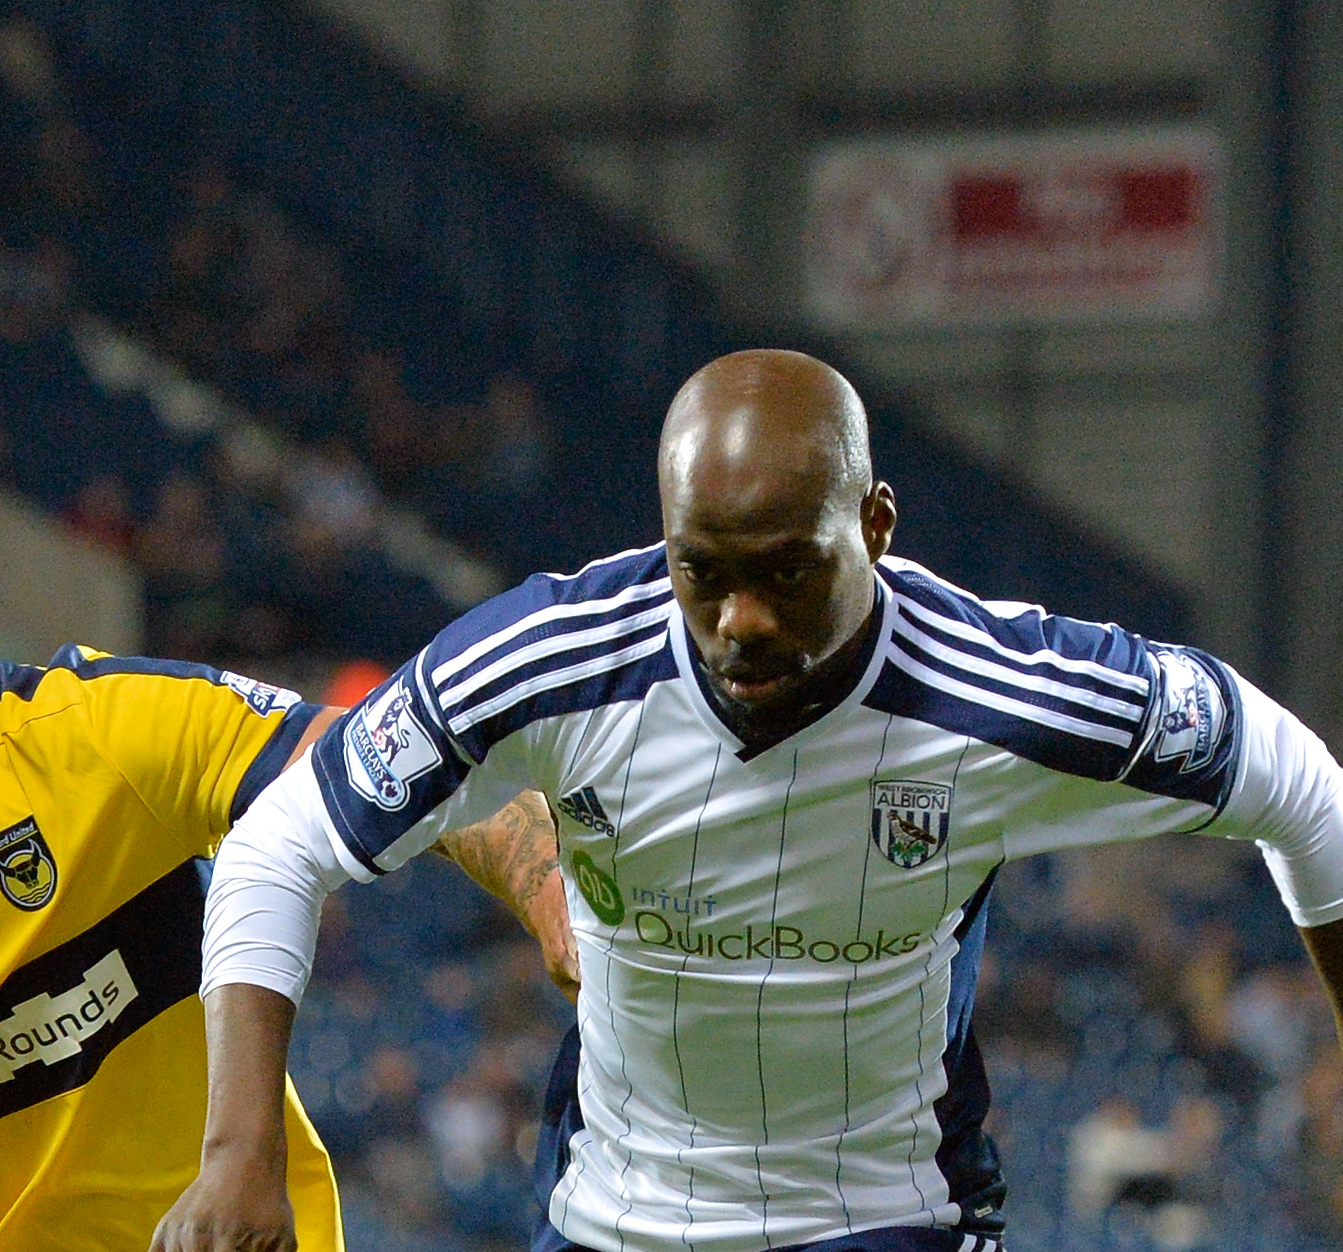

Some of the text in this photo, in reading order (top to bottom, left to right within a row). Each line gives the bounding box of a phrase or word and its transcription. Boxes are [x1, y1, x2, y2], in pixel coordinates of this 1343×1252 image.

[355, 722, 387, 780] BARCLAYS
[876, 791, 946, 810] ALBION
[557, 802, 615, 837] adidas
[632, 887, 717, 916] intuit
[634, 911, 921, 963] QuickBooks
